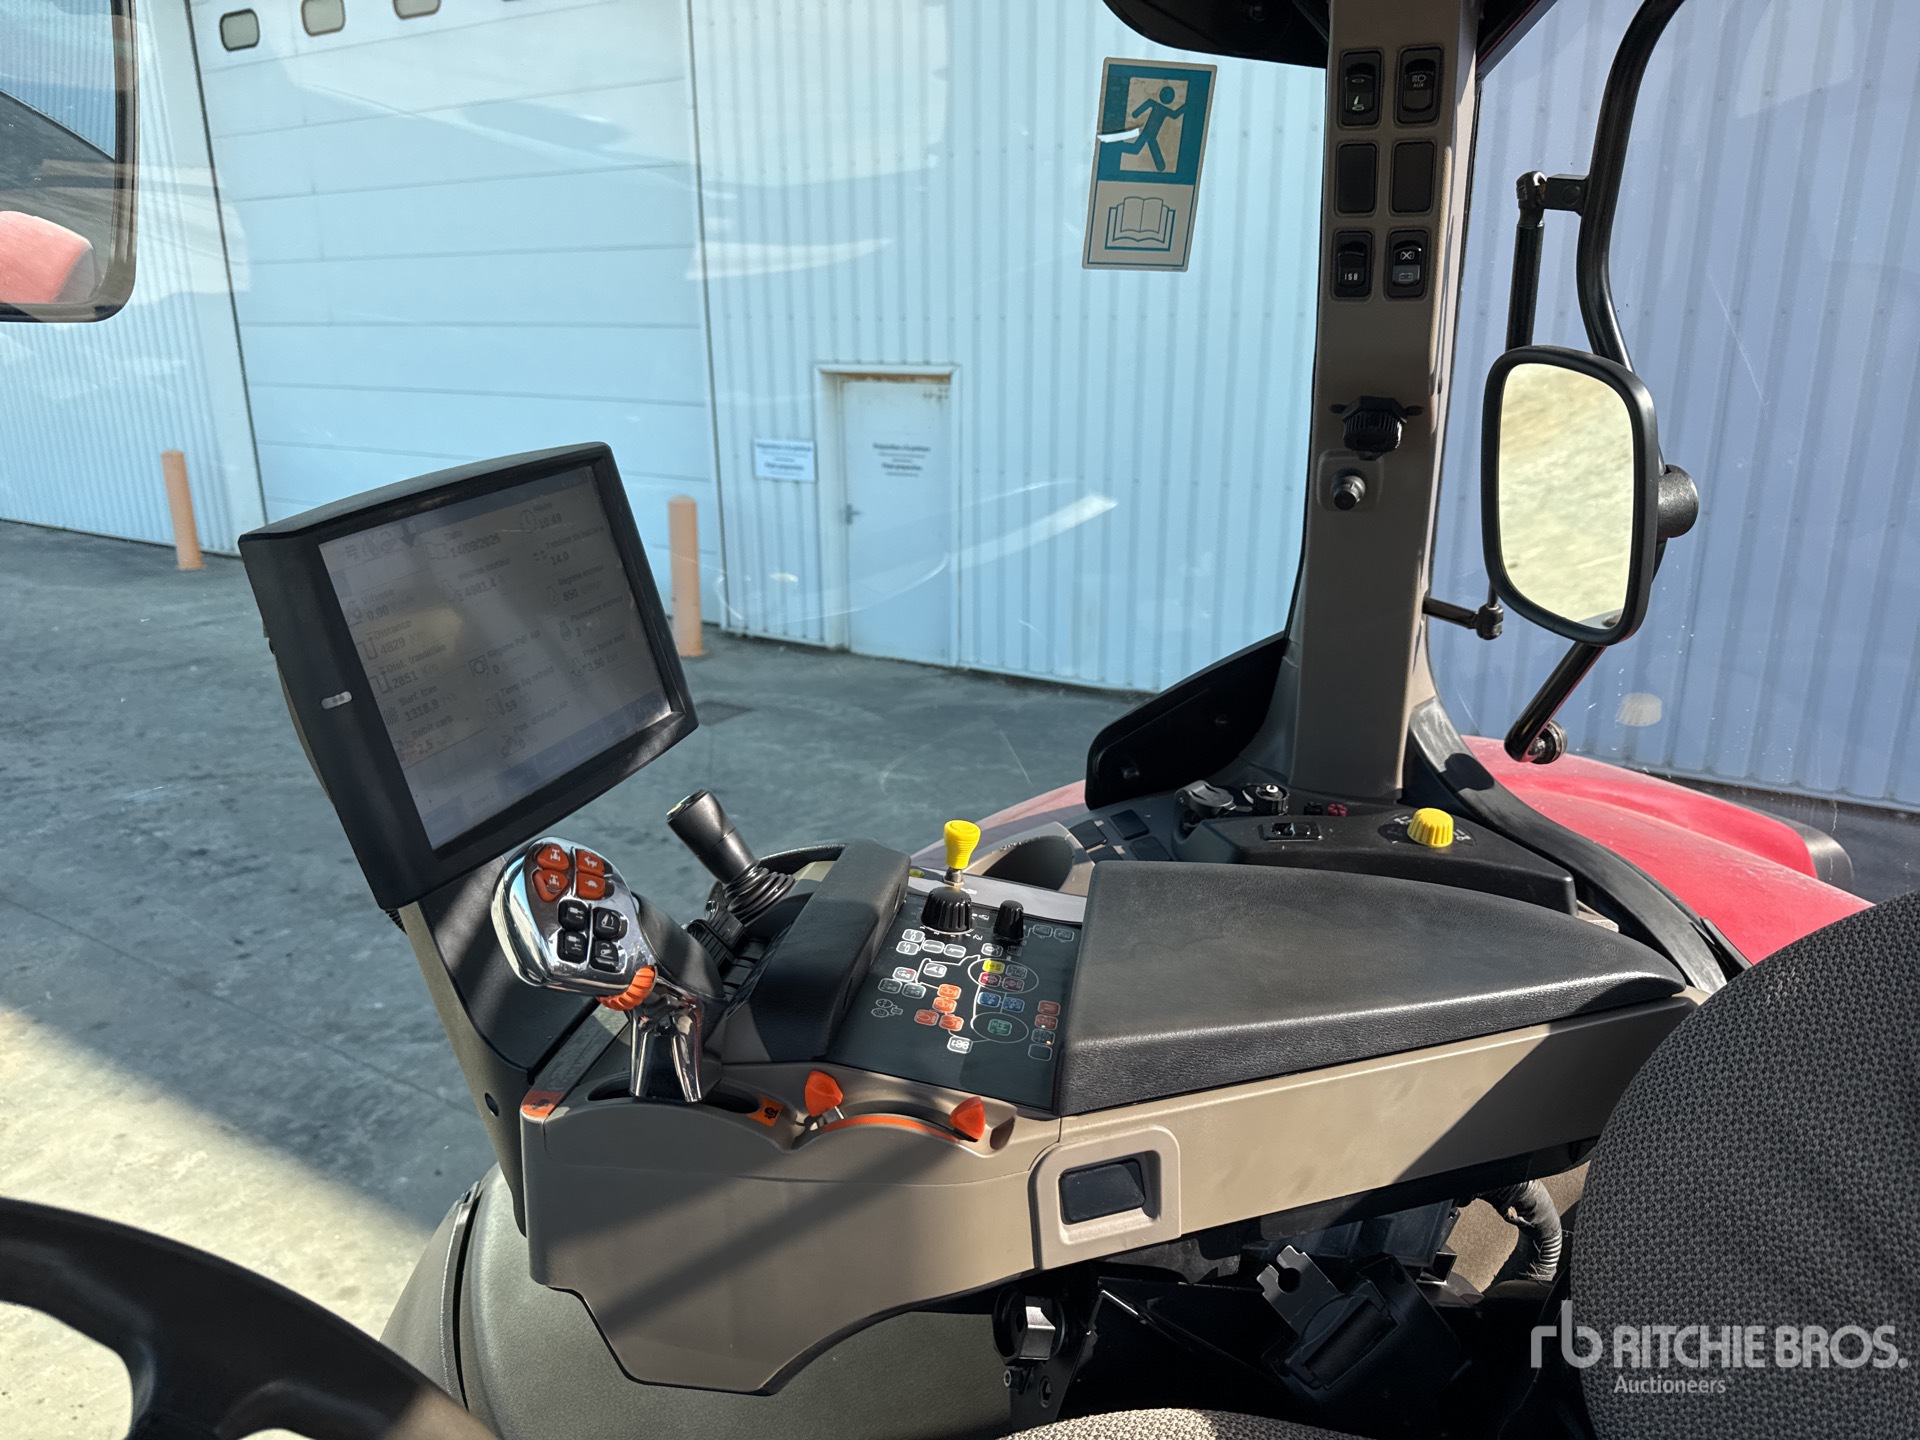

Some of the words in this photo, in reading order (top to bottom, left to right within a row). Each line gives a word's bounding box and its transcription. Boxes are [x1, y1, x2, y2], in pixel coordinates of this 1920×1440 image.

[1344, 272, 1359, 281] ISB
[562, 588, 579, 602] 850
[375, 620, 411, 639] Distance
[380, 637, 406, 654] 4829
[392, 670, 418, 689] 2851
[505, 700, 517, 713] 59
